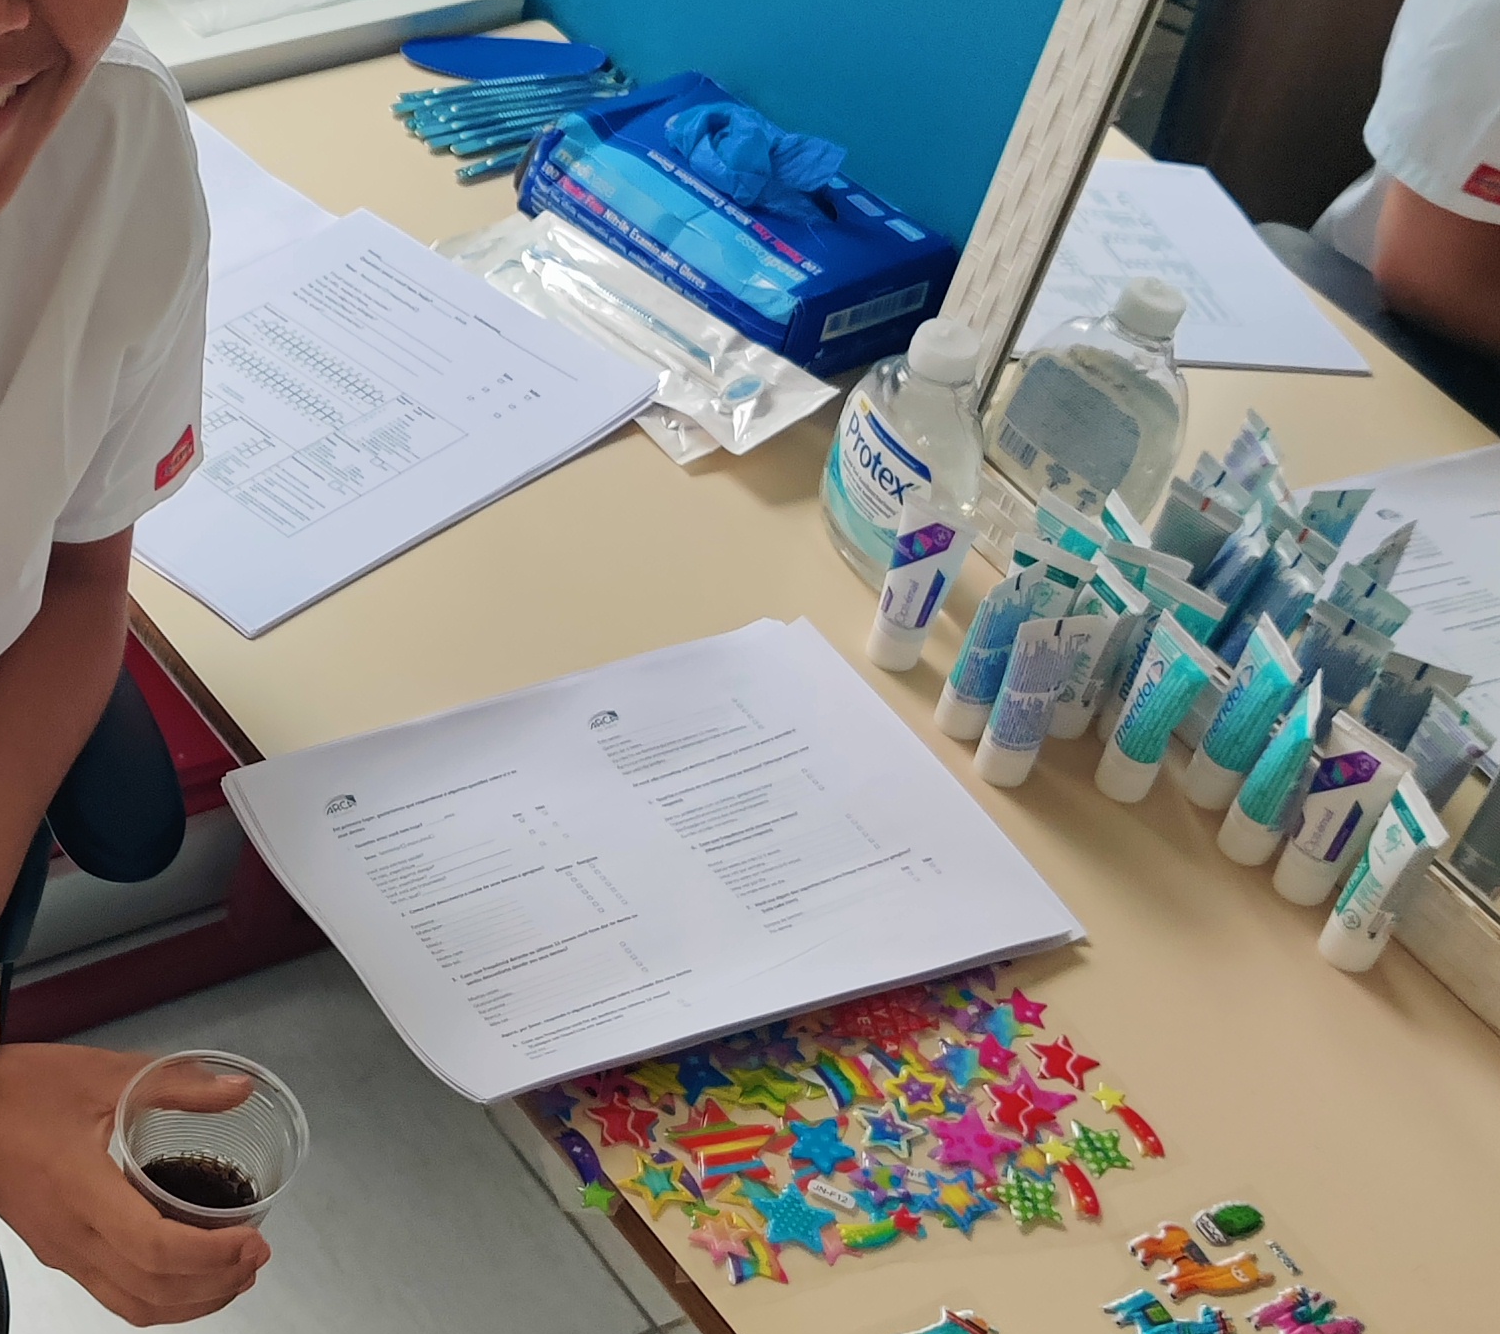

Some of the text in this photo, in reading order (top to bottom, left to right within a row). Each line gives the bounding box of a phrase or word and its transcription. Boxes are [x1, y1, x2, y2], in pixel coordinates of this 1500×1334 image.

[604, 210, 631, 233] Nitrile
[678, 264, 707, 289] Gloves
[846, 410, 914, 505] Protex
[1115, 673, 1156, 746] meridol
[812, 1184, 849, 1204] JN-F12
